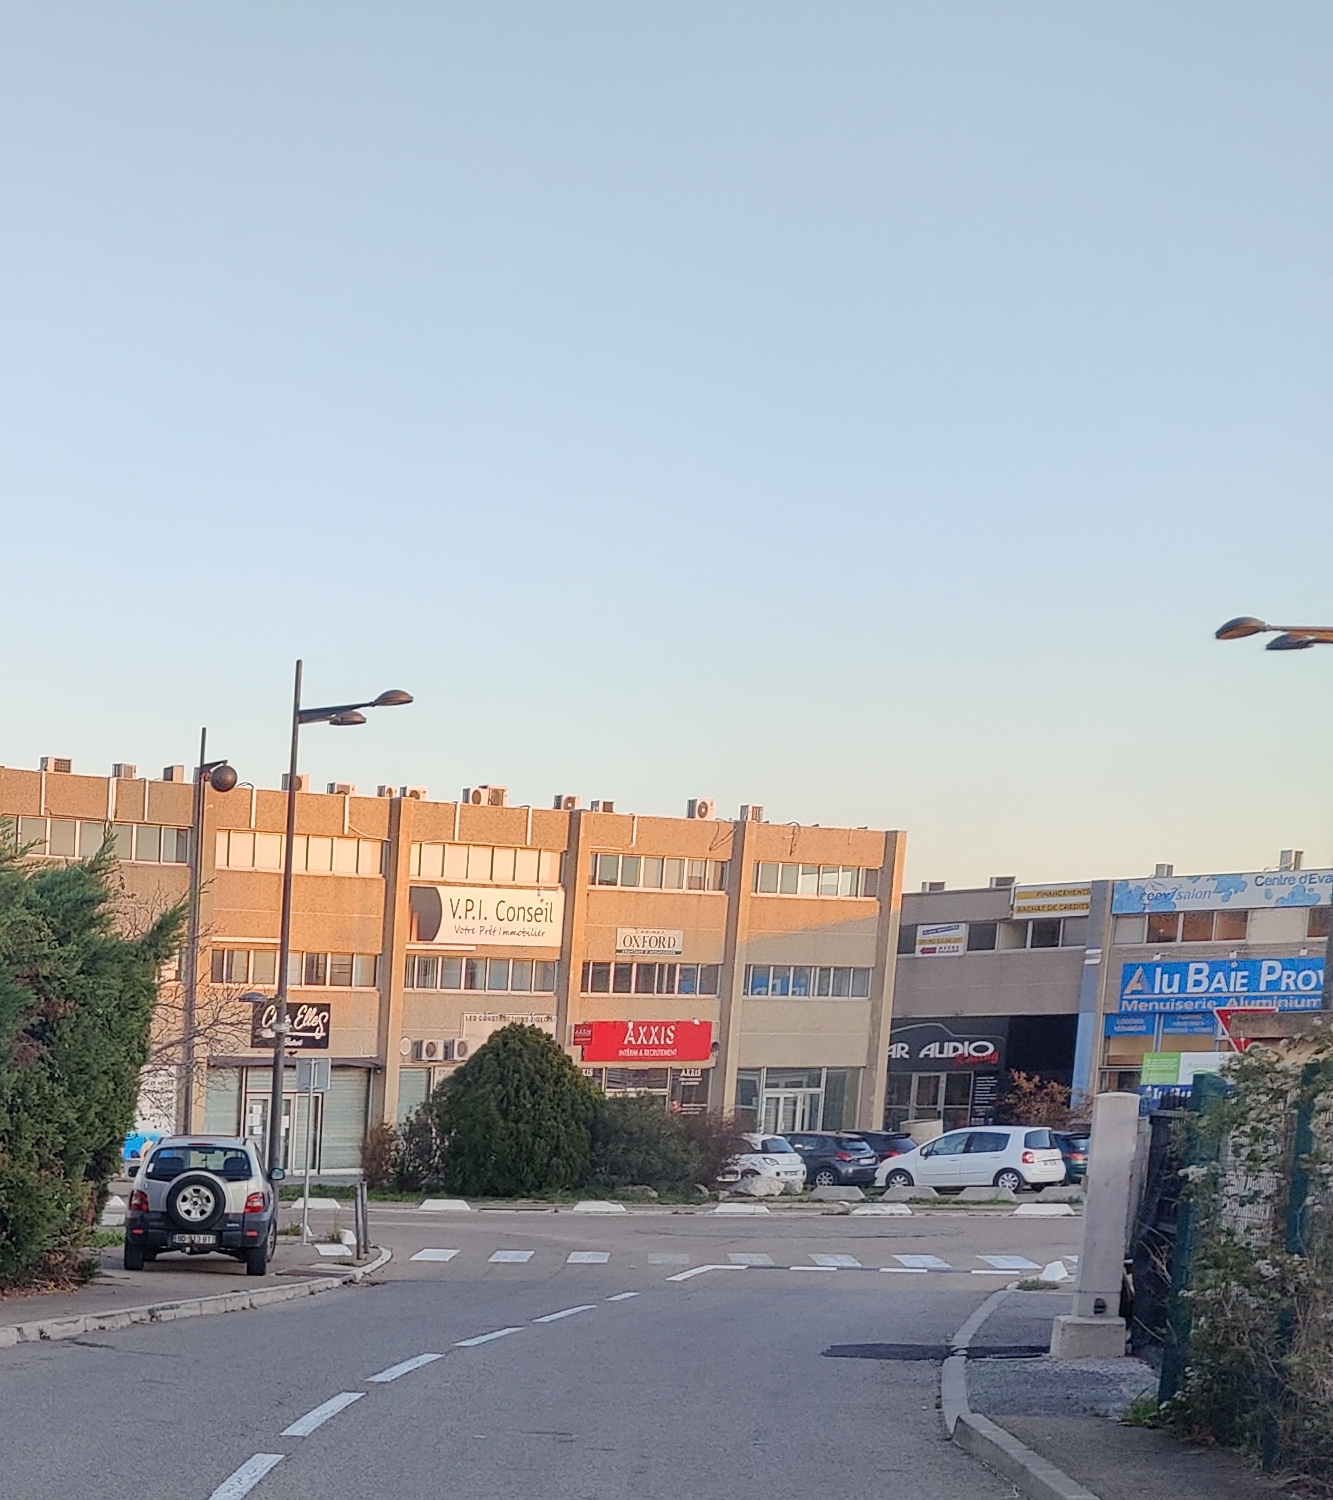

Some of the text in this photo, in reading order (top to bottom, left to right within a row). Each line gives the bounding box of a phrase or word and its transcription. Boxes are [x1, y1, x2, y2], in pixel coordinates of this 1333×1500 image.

[1255, 875, 1296, 886] Centre
[449, 898, 554, 923] V.P.I. Conseil
[454, 925, 475, 935] Votre
[623, 934, 676, 949] OXFORD
[1121, 999, 1217, 1011] Menuiserie
[623, 1024, 676, 1045] AXXIS
[887, 1041, 995, 1058] AR AUDIO
